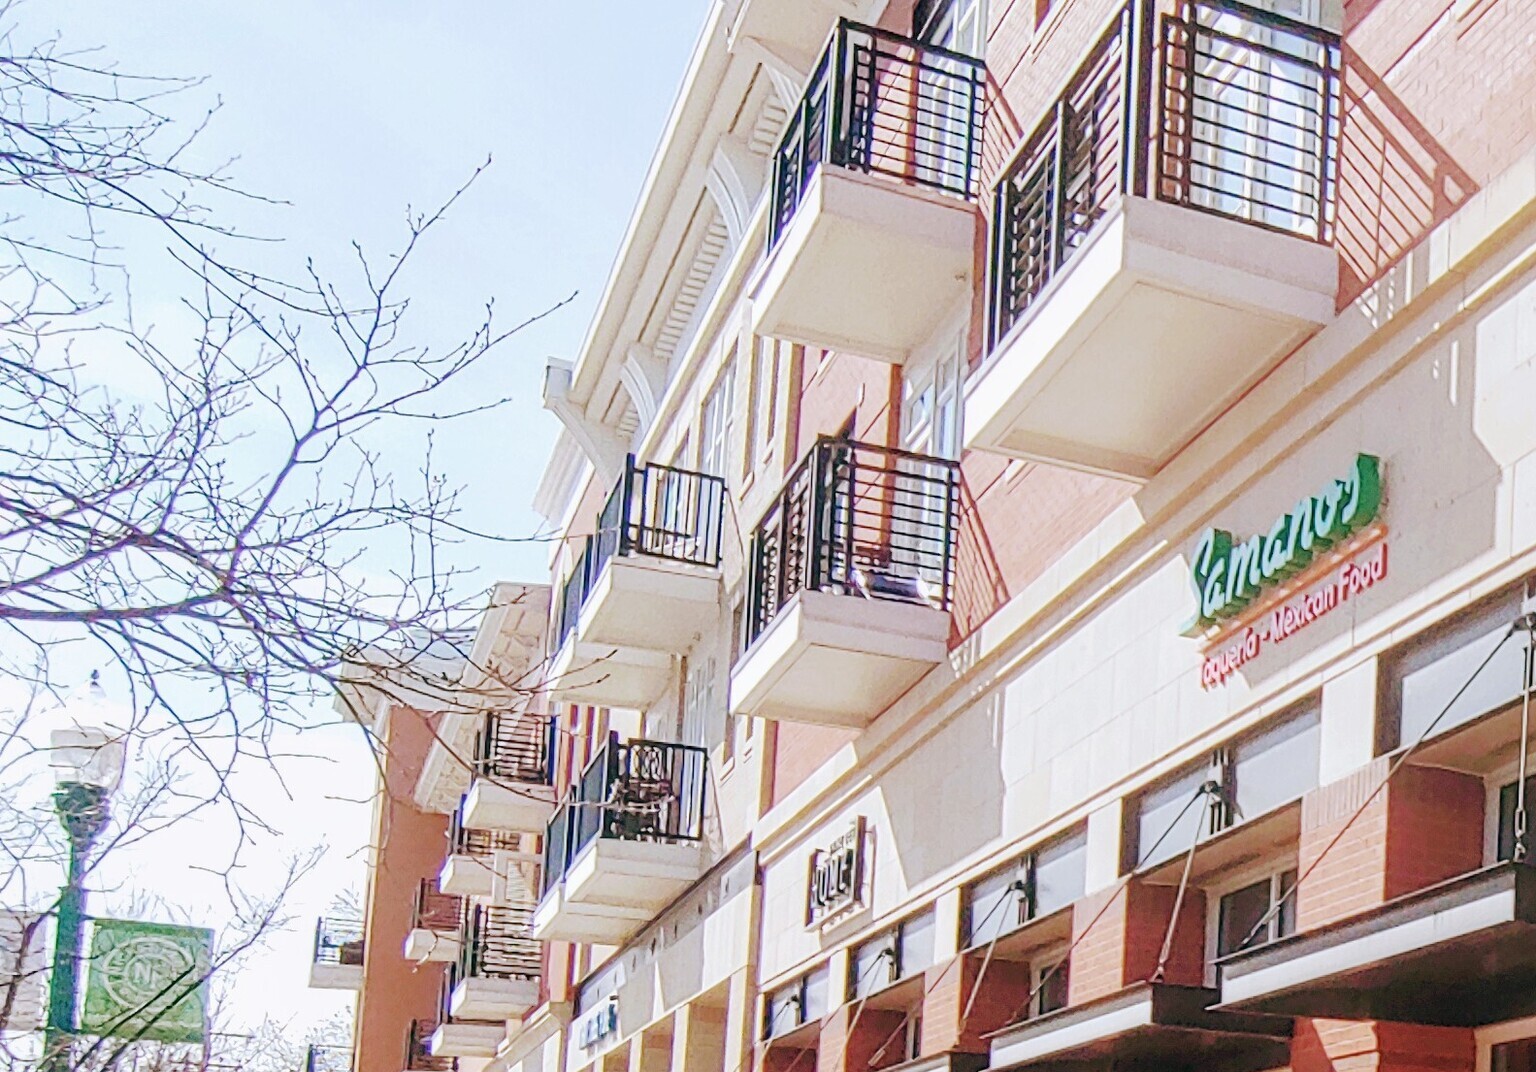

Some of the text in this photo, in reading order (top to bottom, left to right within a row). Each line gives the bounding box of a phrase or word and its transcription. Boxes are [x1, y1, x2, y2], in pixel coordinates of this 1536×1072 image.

[1179, 452, 1380, 636] Samanos
[1270, 582, 1339, 643] Mexican
[1338, 543, 1388, 601] Food
